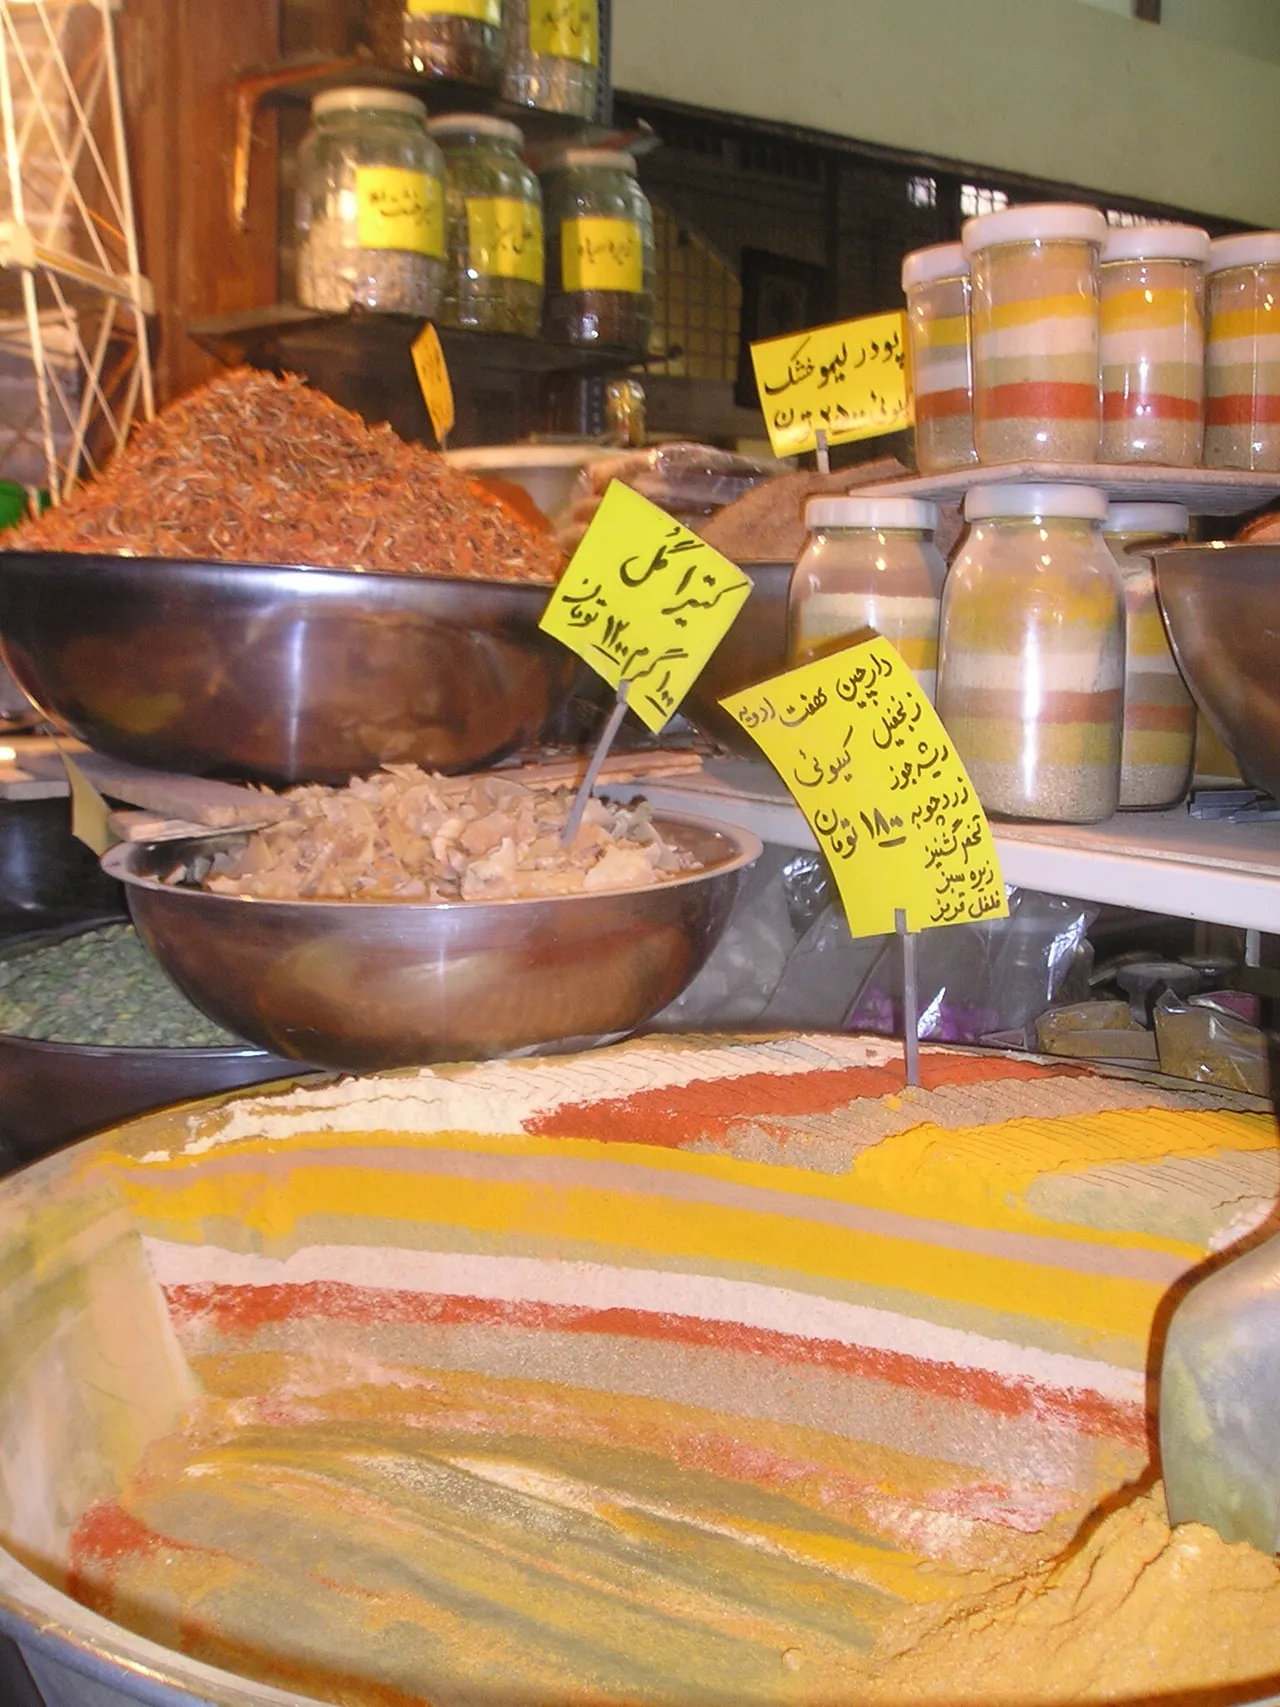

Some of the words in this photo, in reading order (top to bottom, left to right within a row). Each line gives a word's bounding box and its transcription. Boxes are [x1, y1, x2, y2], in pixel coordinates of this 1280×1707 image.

[764, 335, 815, 396] خشک
[817, 342, 847, 389] لیمو
[836, 653, 893, 710] دارچین
[813, 808, 859, 860] تومان
[935, 870, 965, 895] سبز
[969, 859, 995, 893] زیره
[968, 890, 1002, 919] فلفل
